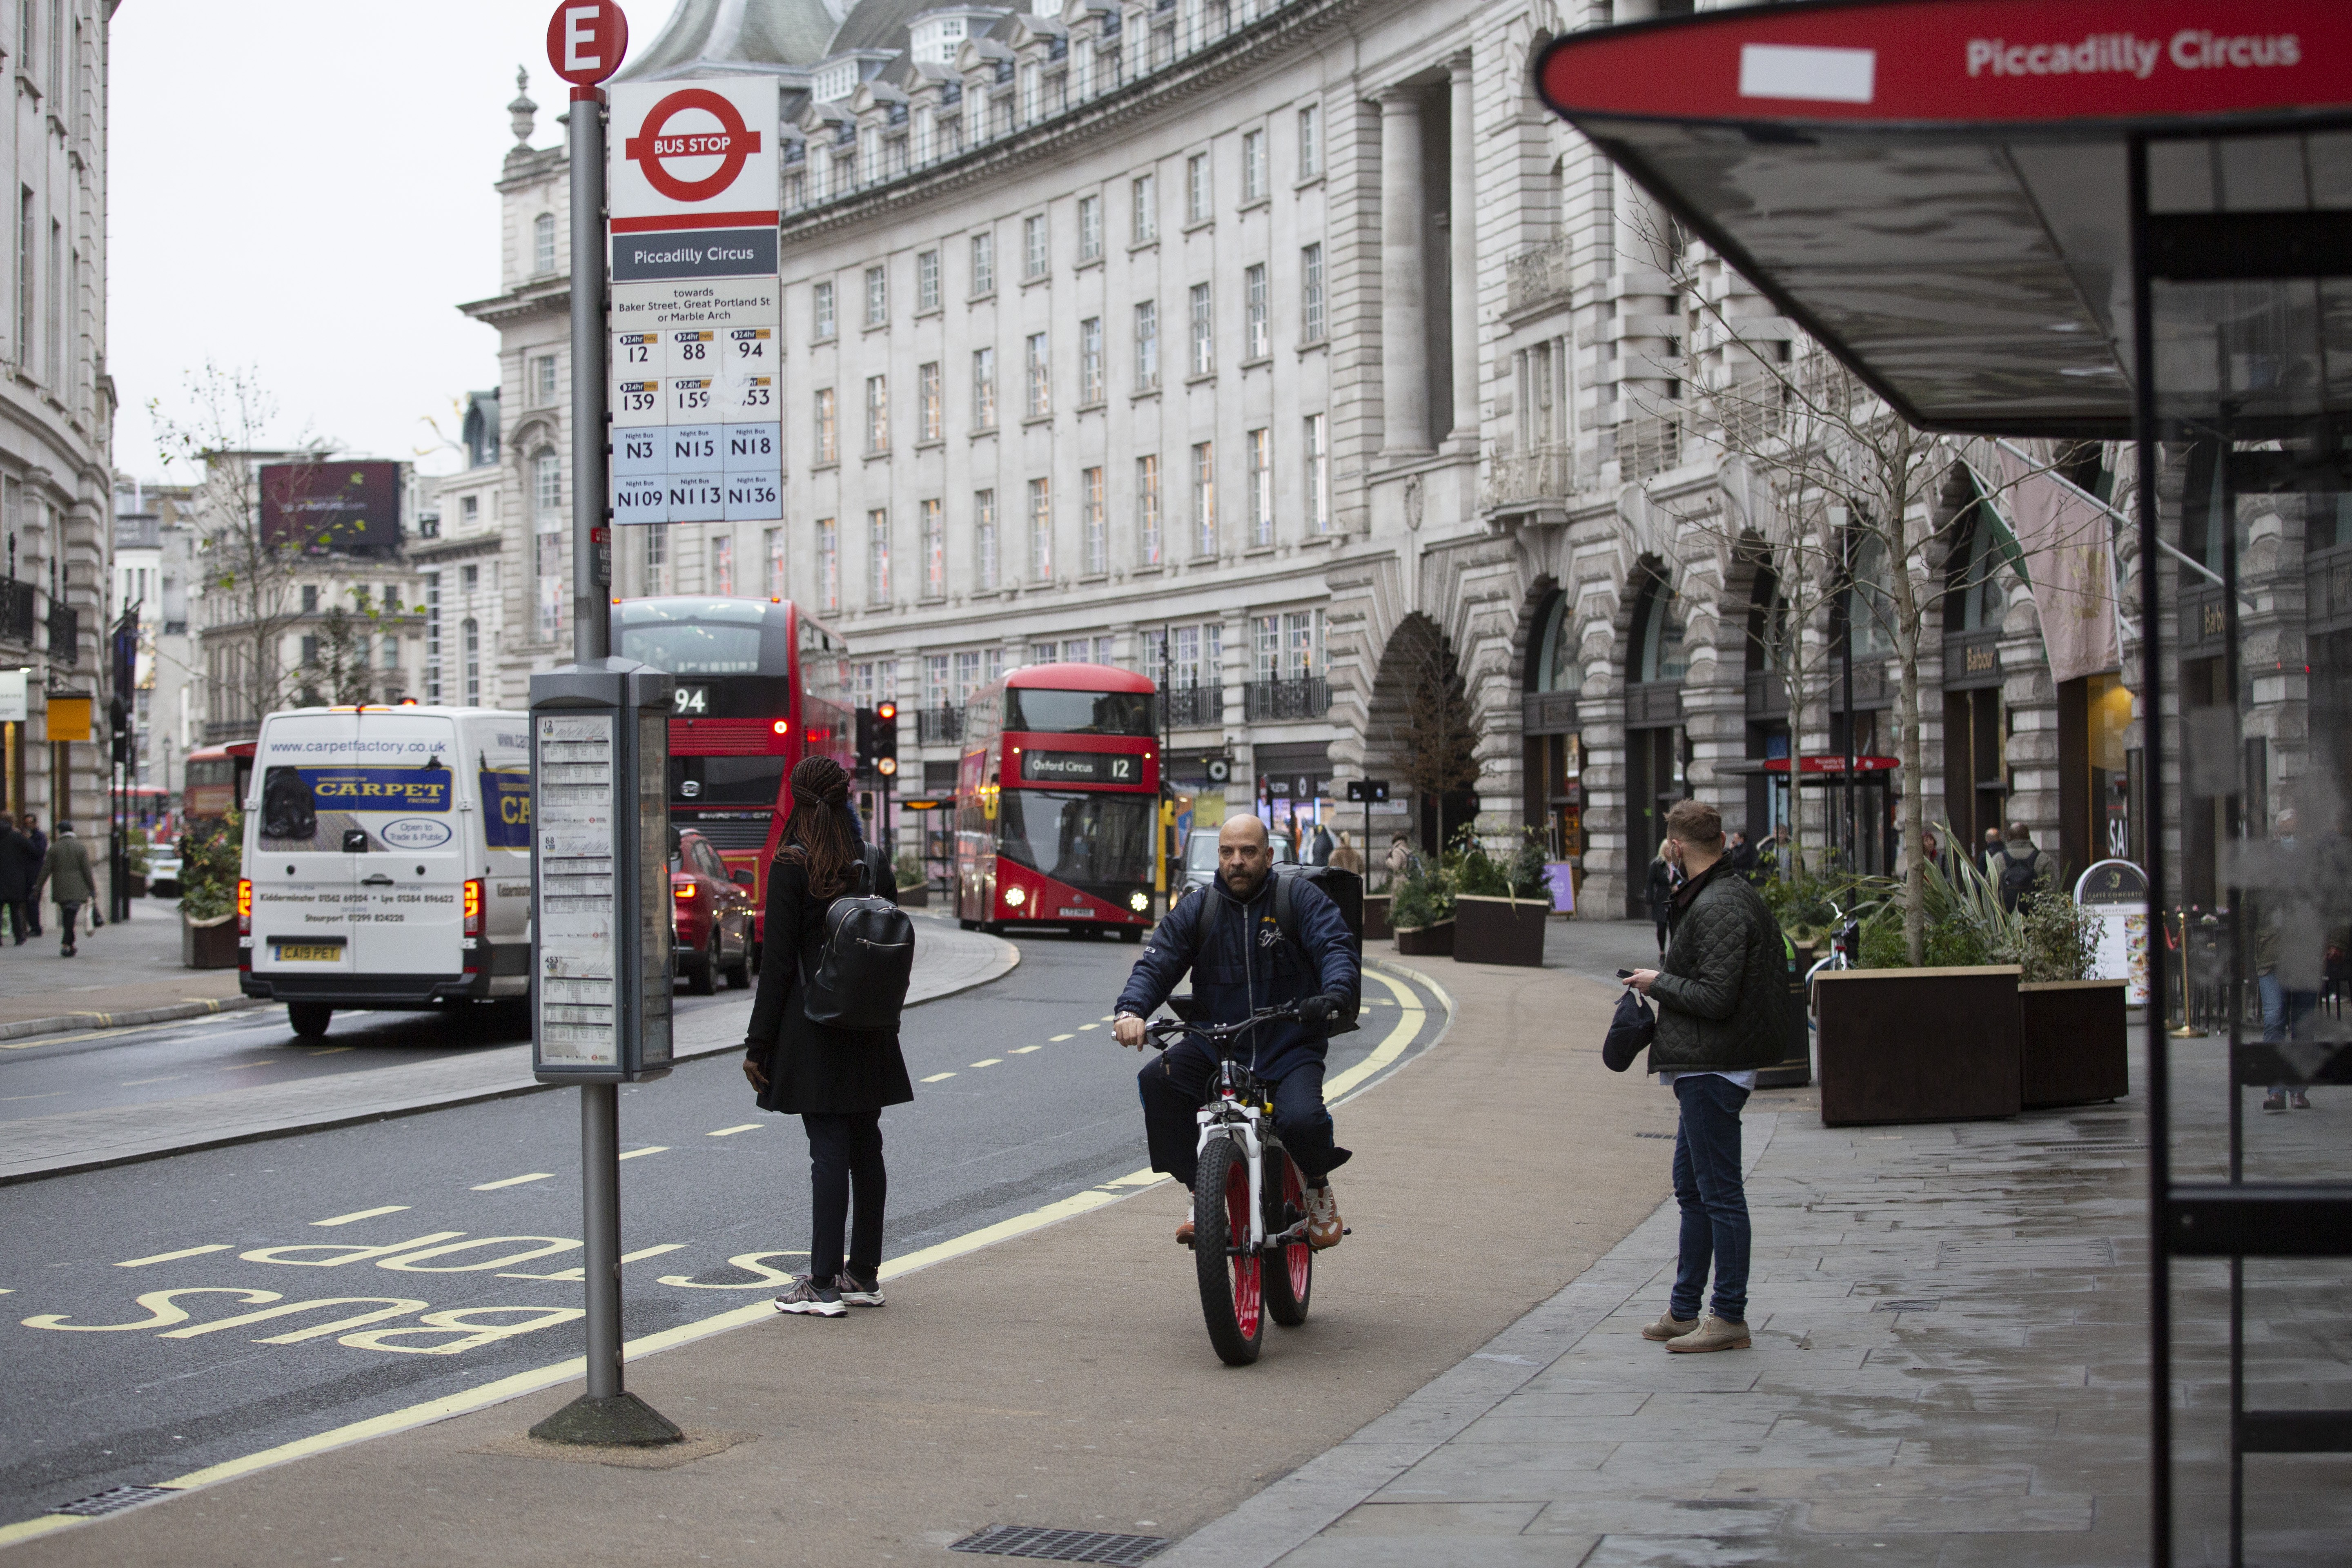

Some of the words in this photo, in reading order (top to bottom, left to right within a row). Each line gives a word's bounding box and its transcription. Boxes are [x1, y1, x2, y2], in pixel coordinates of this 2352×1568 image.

[565, 5, 600, 71] E
[1965, 32, 2161, 78] Piccadilly
[2168, 29, 2301, 69] Circus
[654, 139, 684, 154] BUS
[689, 137, 731, 151] STOP
[635, 248, 703, 264] Piccadilly
[707, 247, 754, 261] Circus
[674, 288, 713, 297] towards
[619, 303, 645, 312] Baker
[648, 302, 681, 310] Street,
[684, 300, 712, 309] Great
[715, 298, 757, 307] Portland
[760, 297, 771, 306] St
[671, 312, 704, 322] Marble
[708, 311, 731, 320] Arch
[627, 336, 643, 344] 24hr
[681, 333, 699, 341] 24hr
[737, 331, 755, 339] 24hr
[629, 346, 648, 363] 12
[683, 343, 706, 360] 88
[739, 342, 763, 359] 94
[627, 383, 644, 391] 24hr
[624, 394, 654, 410] 139
[679, 392, 710, 408] 159
[742, 389, 770, 406] 53
[627, 441, 653, 459] N3
[676, 441, 713, 458] N15
[732, 438, 771, 455] N18
[618, 491, 662, 507] N109
[670, 487, 721, 505] N113
[729, 488, 775, 504] N136
[1967, 644, 1994, 671] Barbour
[675, 688, 706, 713] 94
[271, 741, 445, 755] www.carpetfactory.co.uk
[1032, 759, 1064, 771] Oxford
[1065, 761, 1094, 773] Circus
[1113, 760, 1129, 777] 12
[315, 783, 444, 797] CARPET
[400, 823, 422, 833] Open
[2109, 818, 2128, 857] SA
[260, 893, 316, 902] Kidderminster
[305, 914, 344, 922] Stourport
[313, 947, 335, 959] PET
